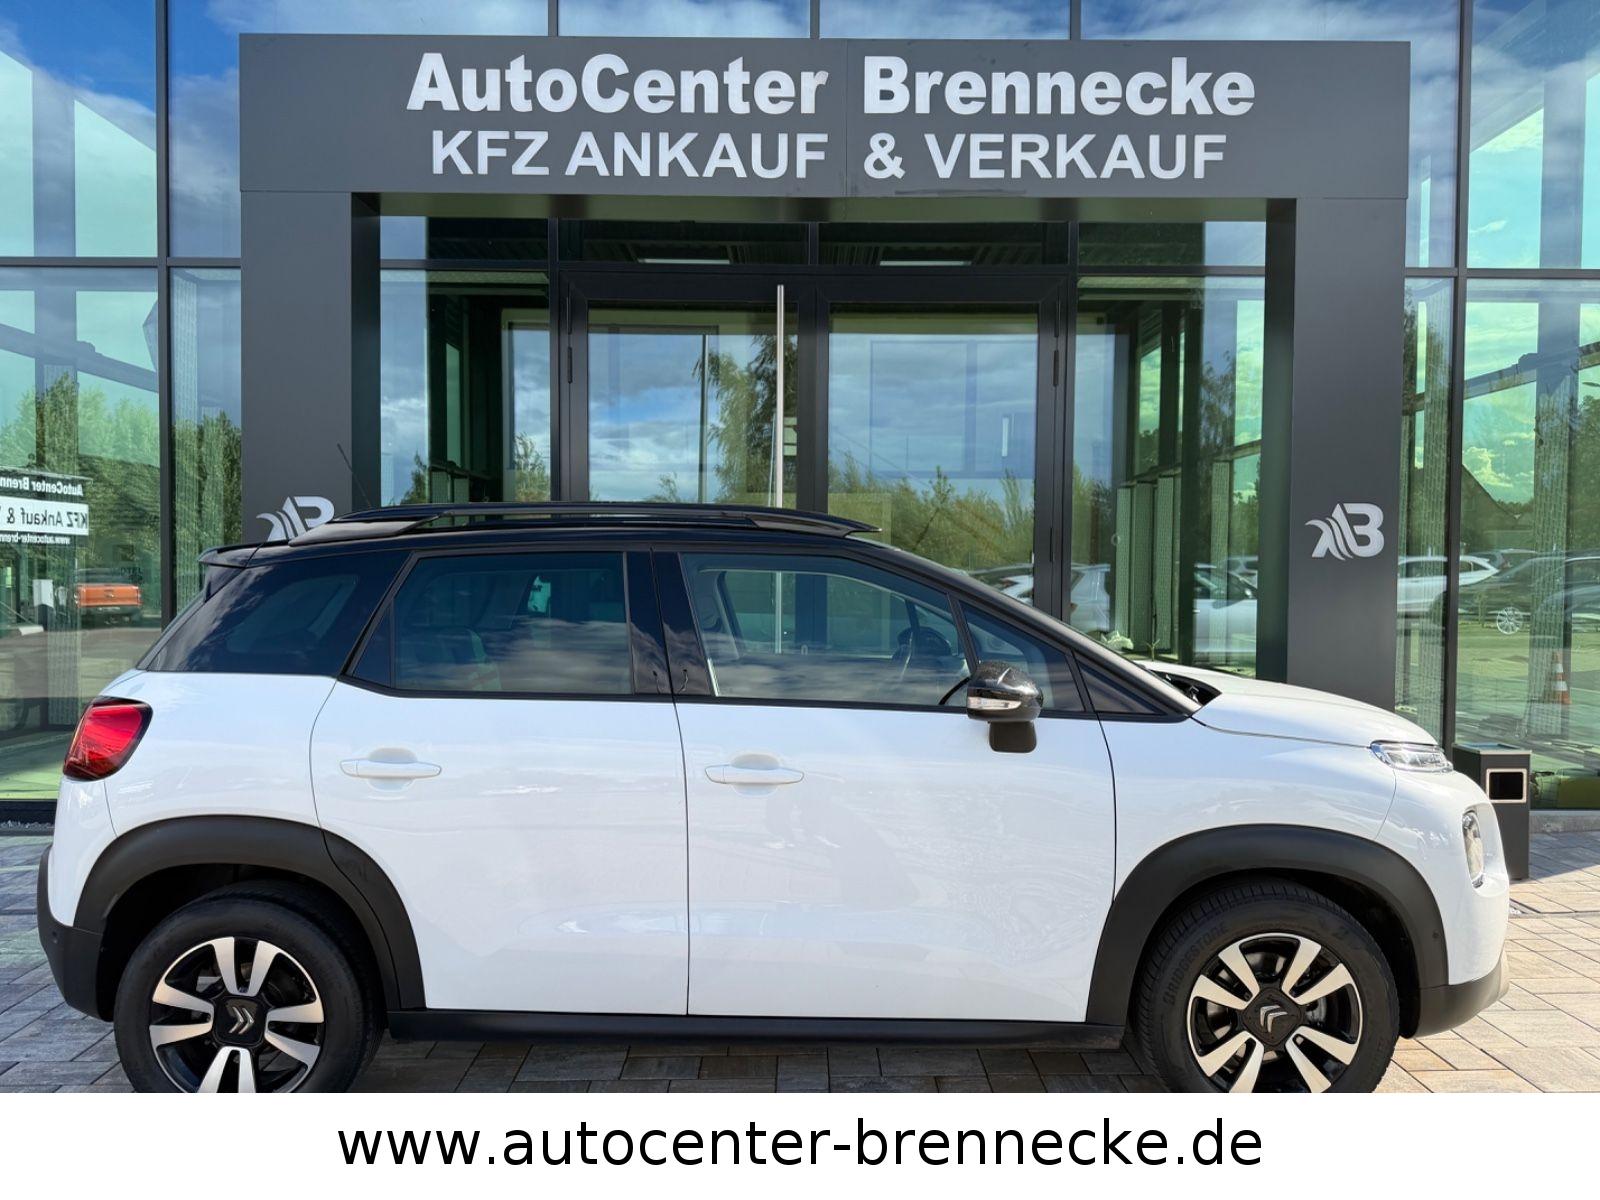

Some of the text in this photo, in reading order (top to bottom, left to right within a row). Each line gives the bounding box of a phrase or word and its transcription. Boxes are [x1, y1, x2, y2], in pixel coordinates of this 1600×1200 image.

[406, 52, 1255, 116] AutoCenter Brennecke
[432, 129, 1227, 179] KFZ ANKAUF & VERKAUF
[1162, 921, 1228, 1005] BRIDGESTONE
